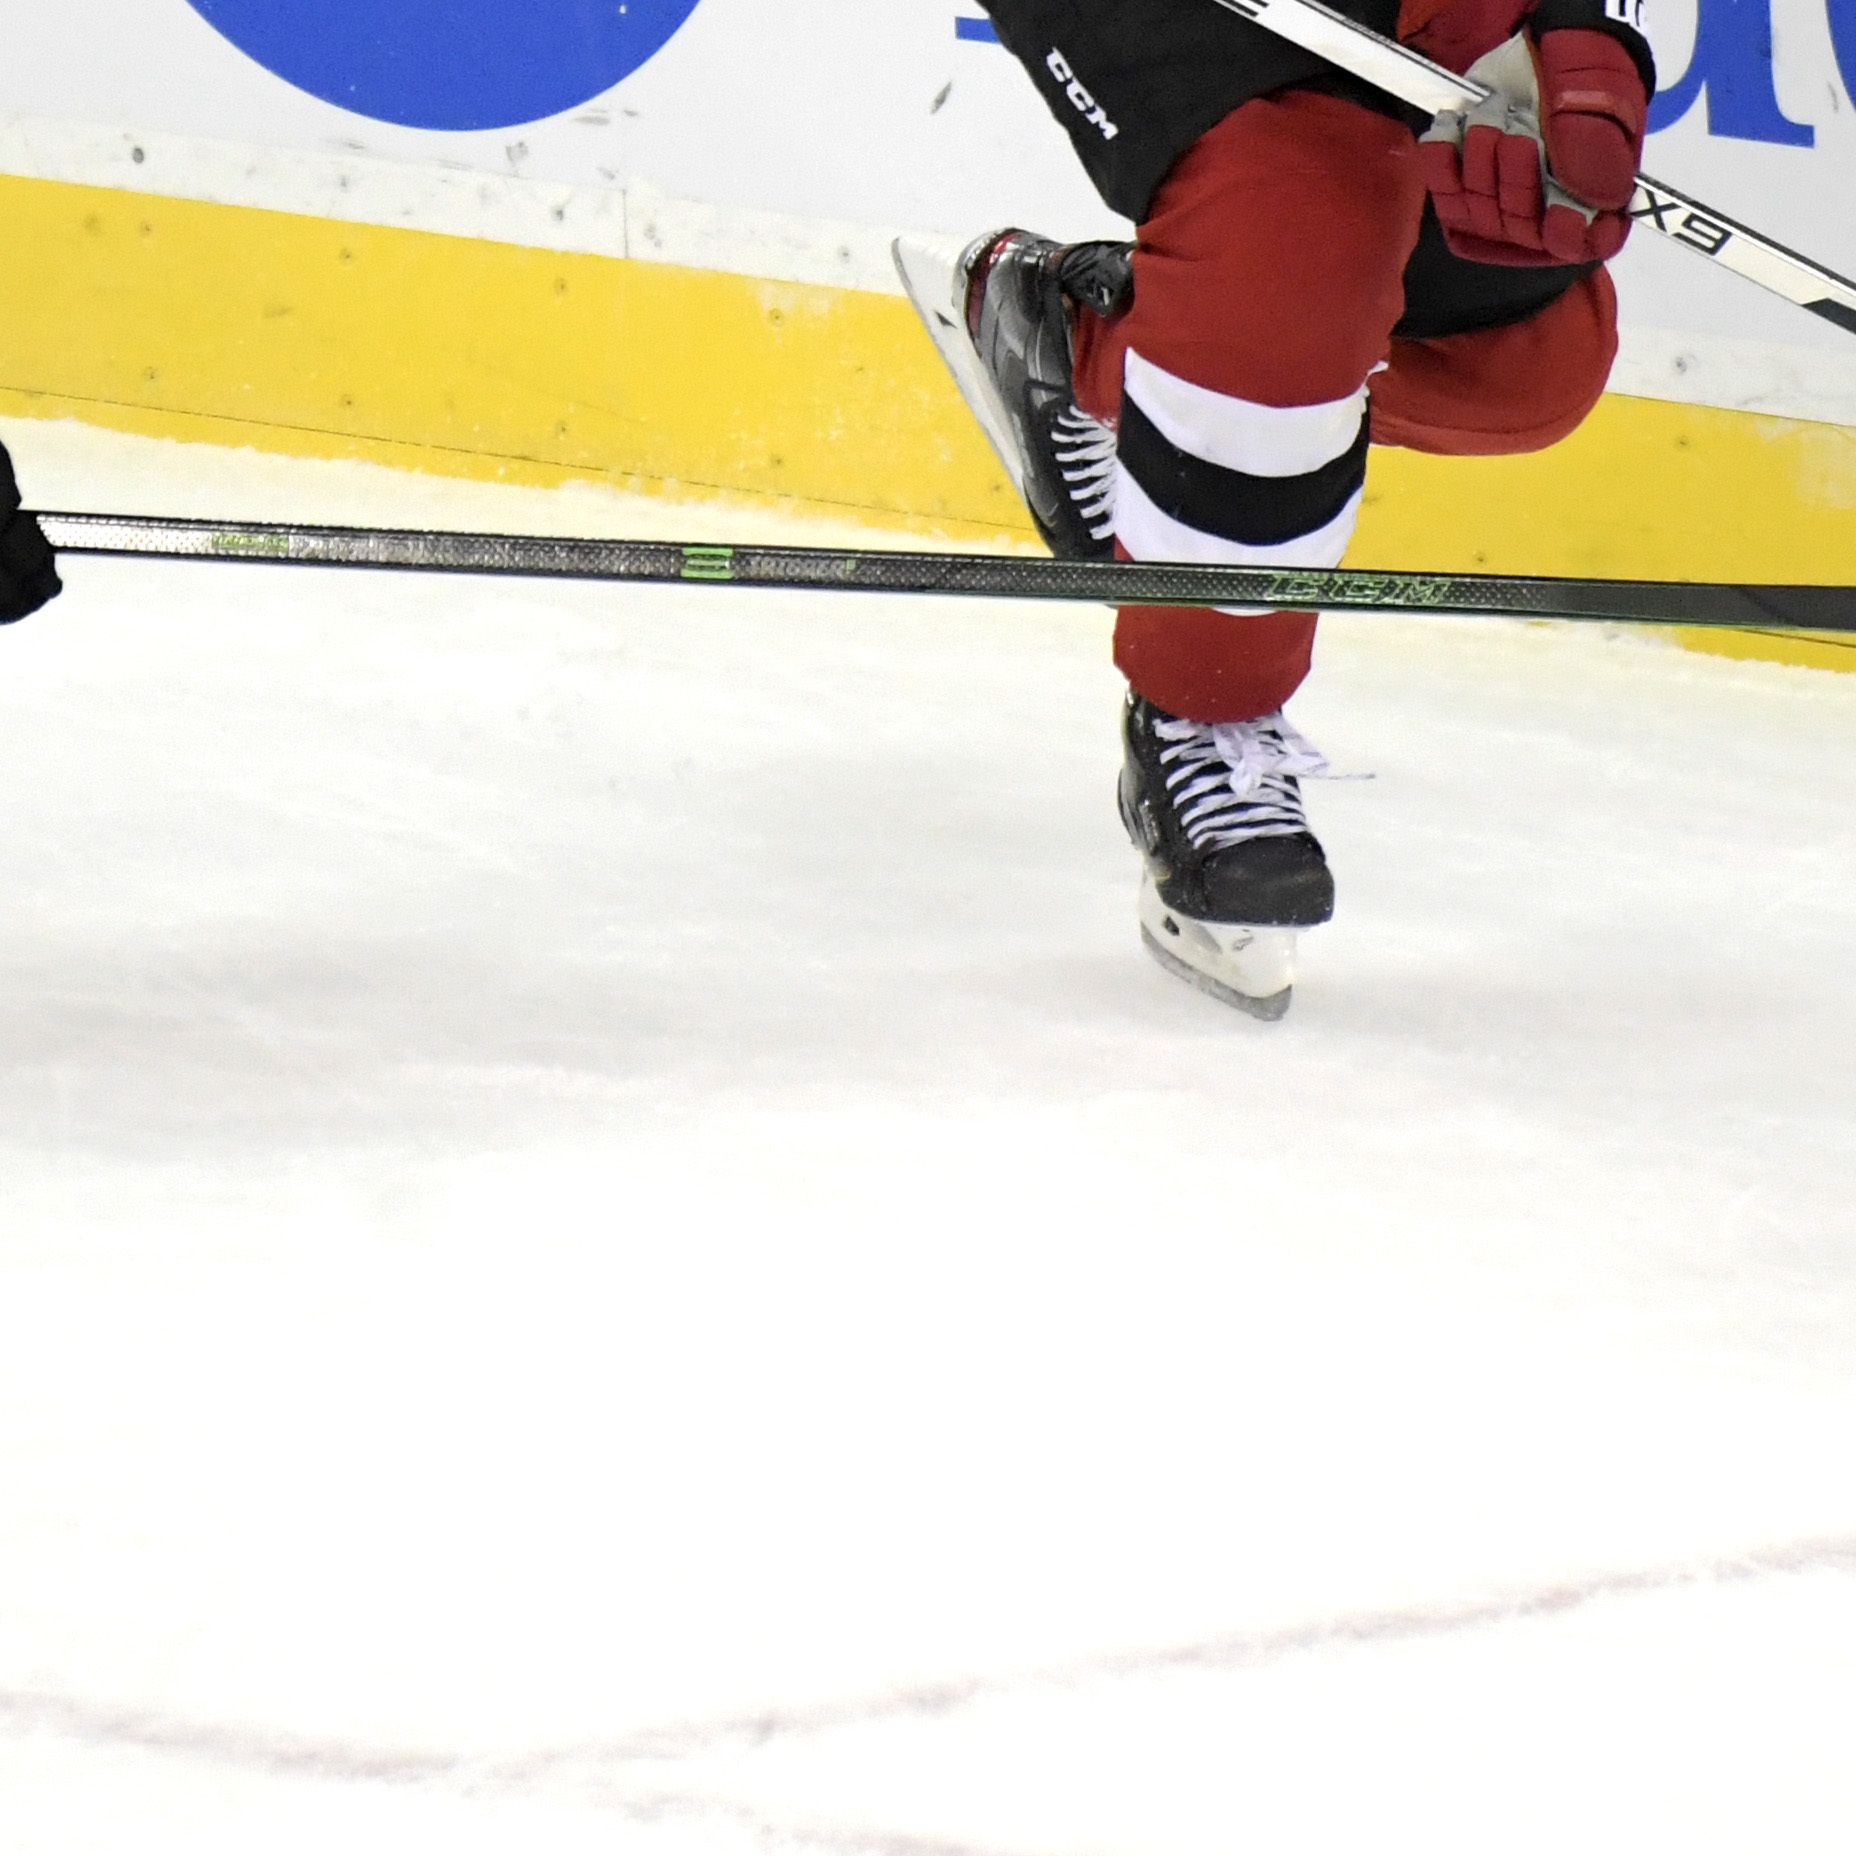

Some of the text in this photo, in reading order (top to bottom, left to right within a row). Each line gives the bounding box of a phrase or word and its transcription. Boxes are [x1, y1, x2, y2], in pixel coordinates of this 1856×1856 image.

[1046, 45, 1119, 141] CCM
[1628, 187, 1734, 257] X9
[1266, 571, 1452, 607] CCM
